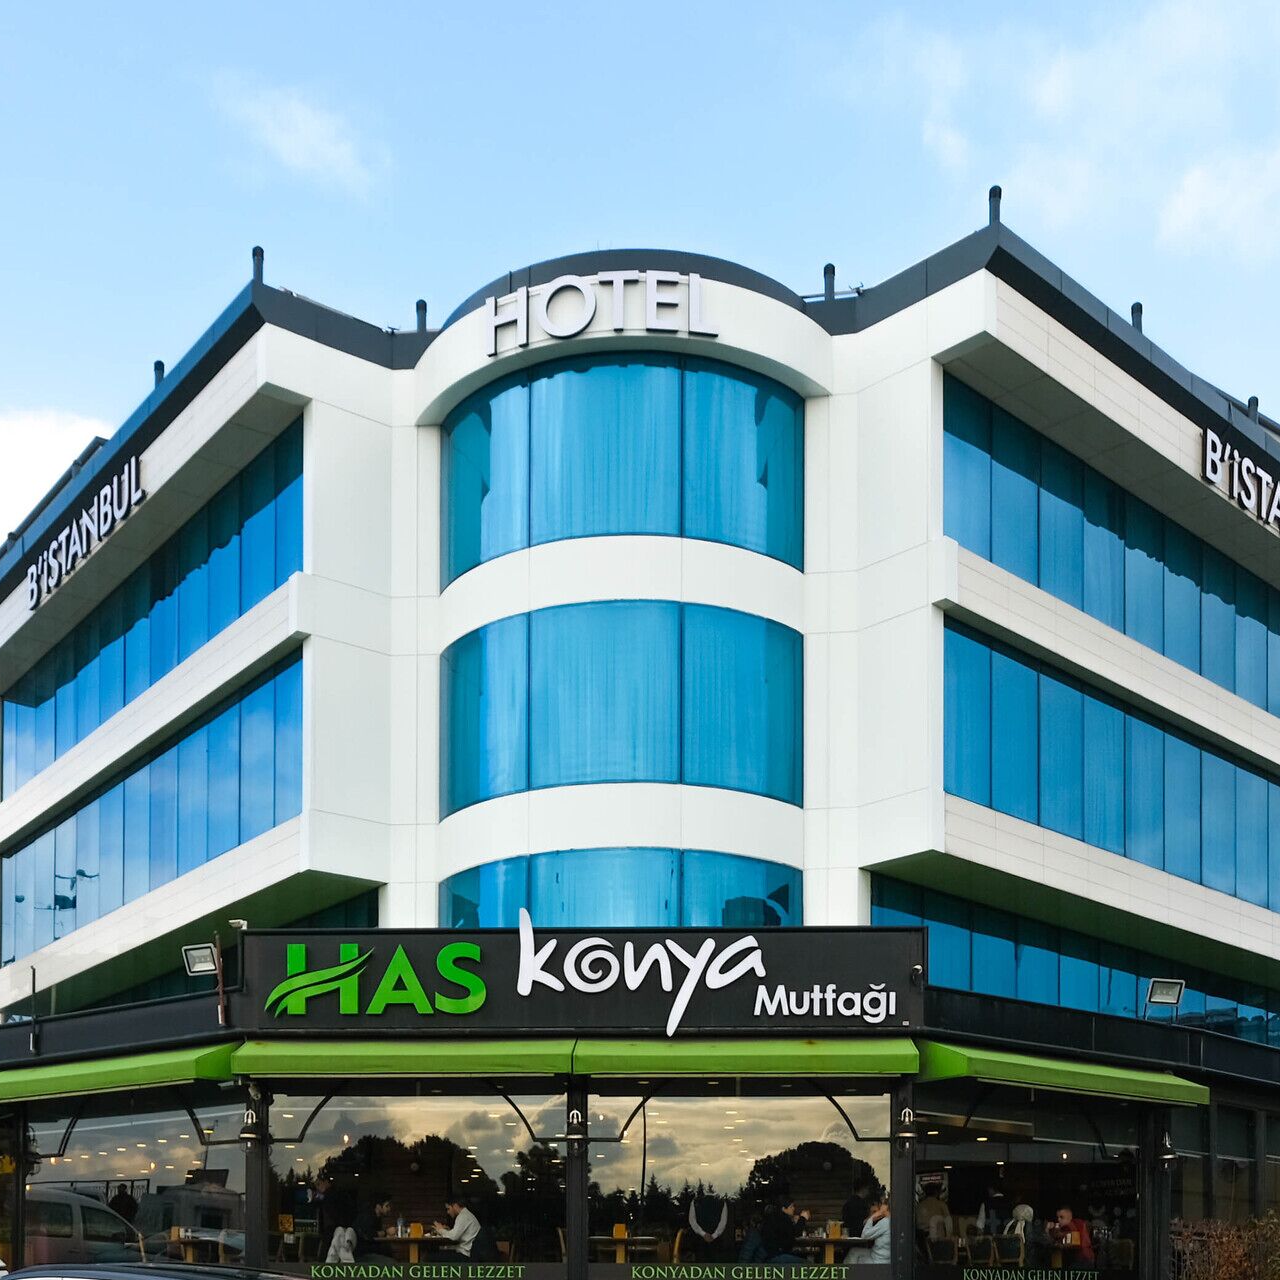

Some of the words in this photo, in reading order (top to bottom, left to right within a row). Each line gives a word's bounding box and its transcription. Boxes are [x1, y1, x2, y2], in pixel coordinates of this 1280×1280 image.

[486, 270, 719, 356] HOTEL
[265, 942, 488, 1018] HAS
[753, 983, 896, 1024] Mutfağı
[311, 1265, 404, 1279] KONYADAN
[409, 1265, 462, 1279] GELEN
[468, 1265, 526, 1278] LEZZET
[631, 1266, 726, 1280] KONYADAN
[731, 1266, 785, 1280] GELEN
[791, 1266, 850, 1279] LEZZET
